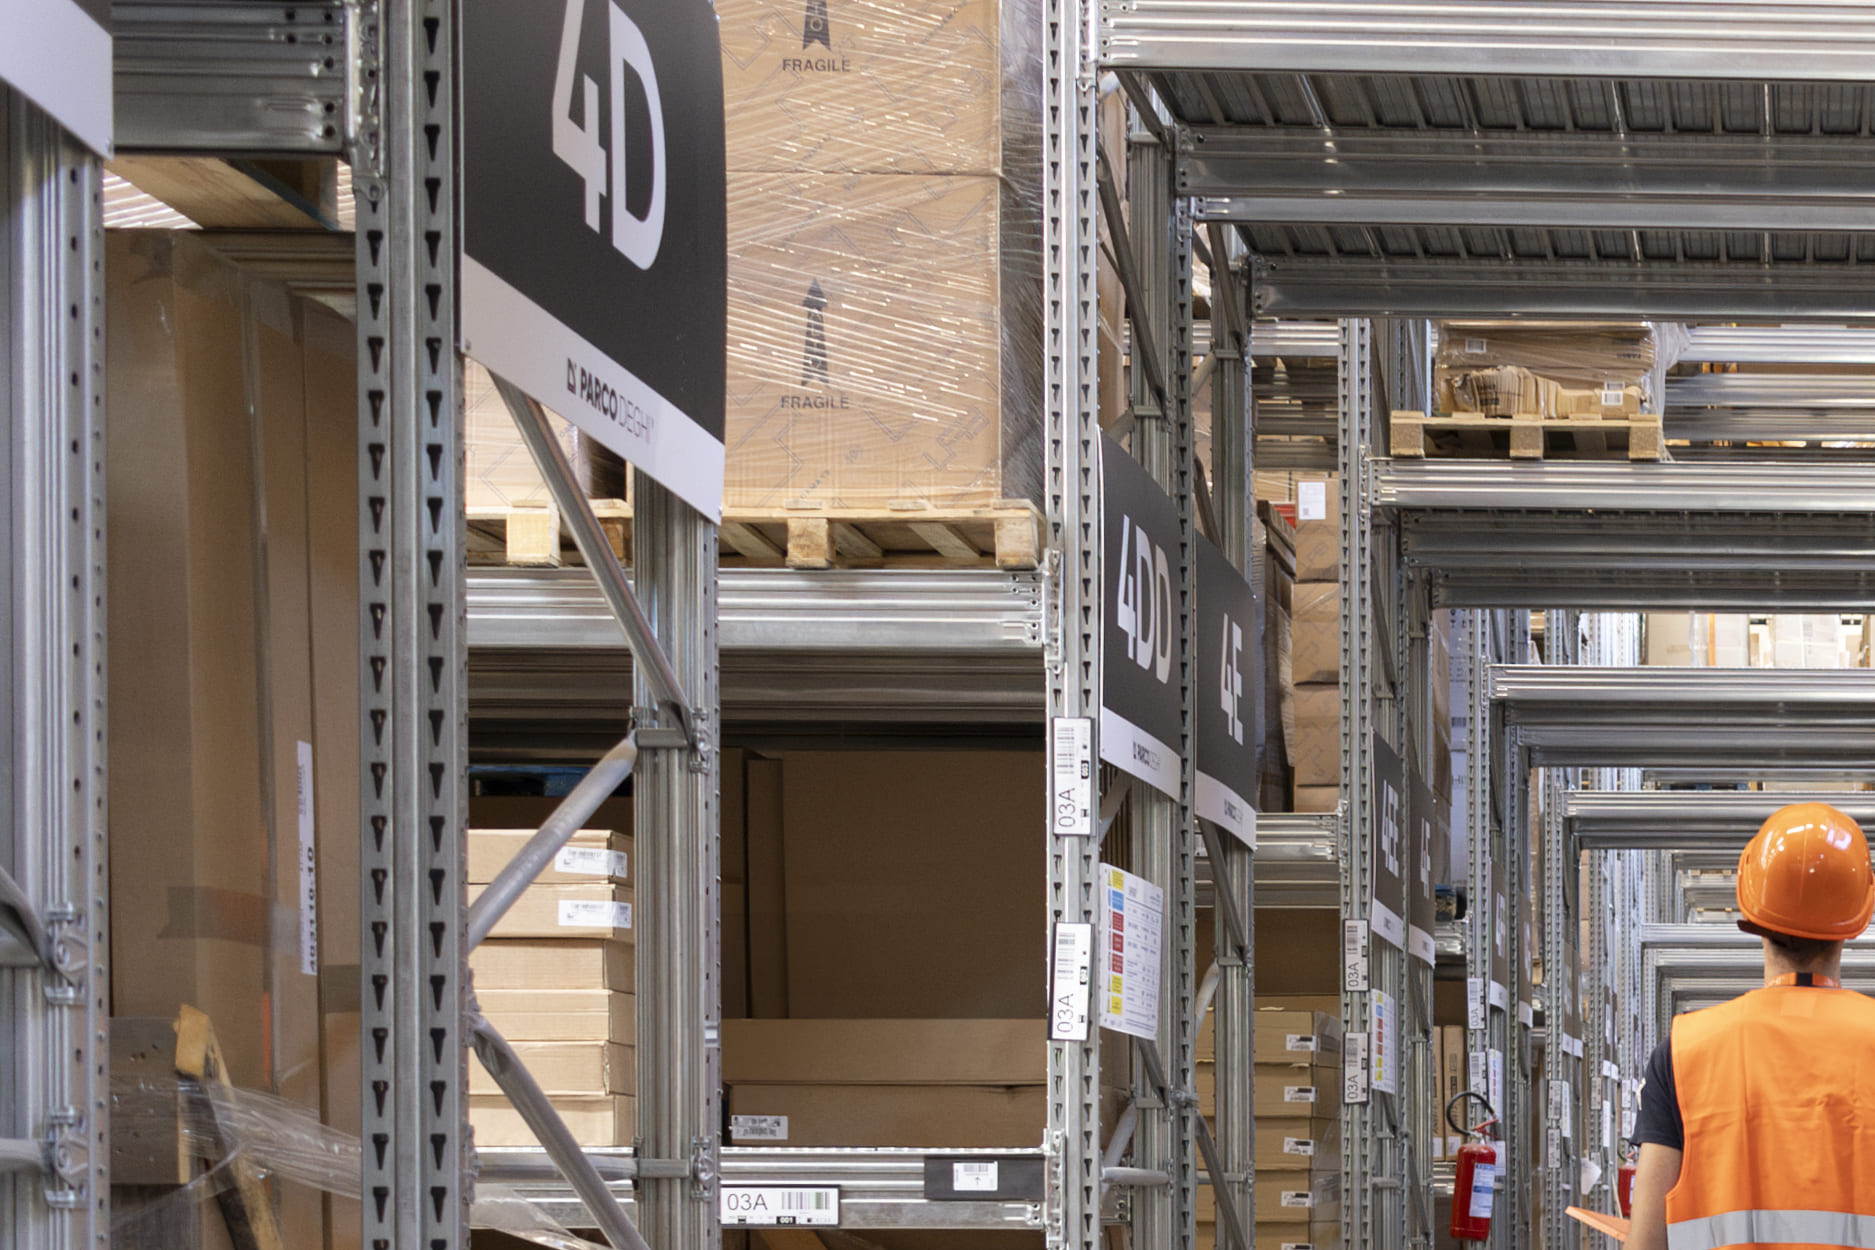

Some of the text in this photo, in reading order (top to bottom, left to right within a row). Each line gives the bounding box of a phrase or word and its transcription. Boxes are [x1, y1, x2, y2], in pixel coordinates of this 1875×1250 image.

[782, 59, 850, 72] FRAGILE
[553, 0, 666, 271] 4D
[781, 395, 849, 409] FRAGILE
[1118, 514, 1171, 684] 4DD
[1221, 613, 1243, 746] 4E
[1058, 787, 1076, 828] 03A
[1348, 962, 1359, 987] 03A
[1057, 993, 1074, 1033] 03A
[1347, 1074, 1359, 1099] 03A
[727, 1193, 768, 1211] 03A
